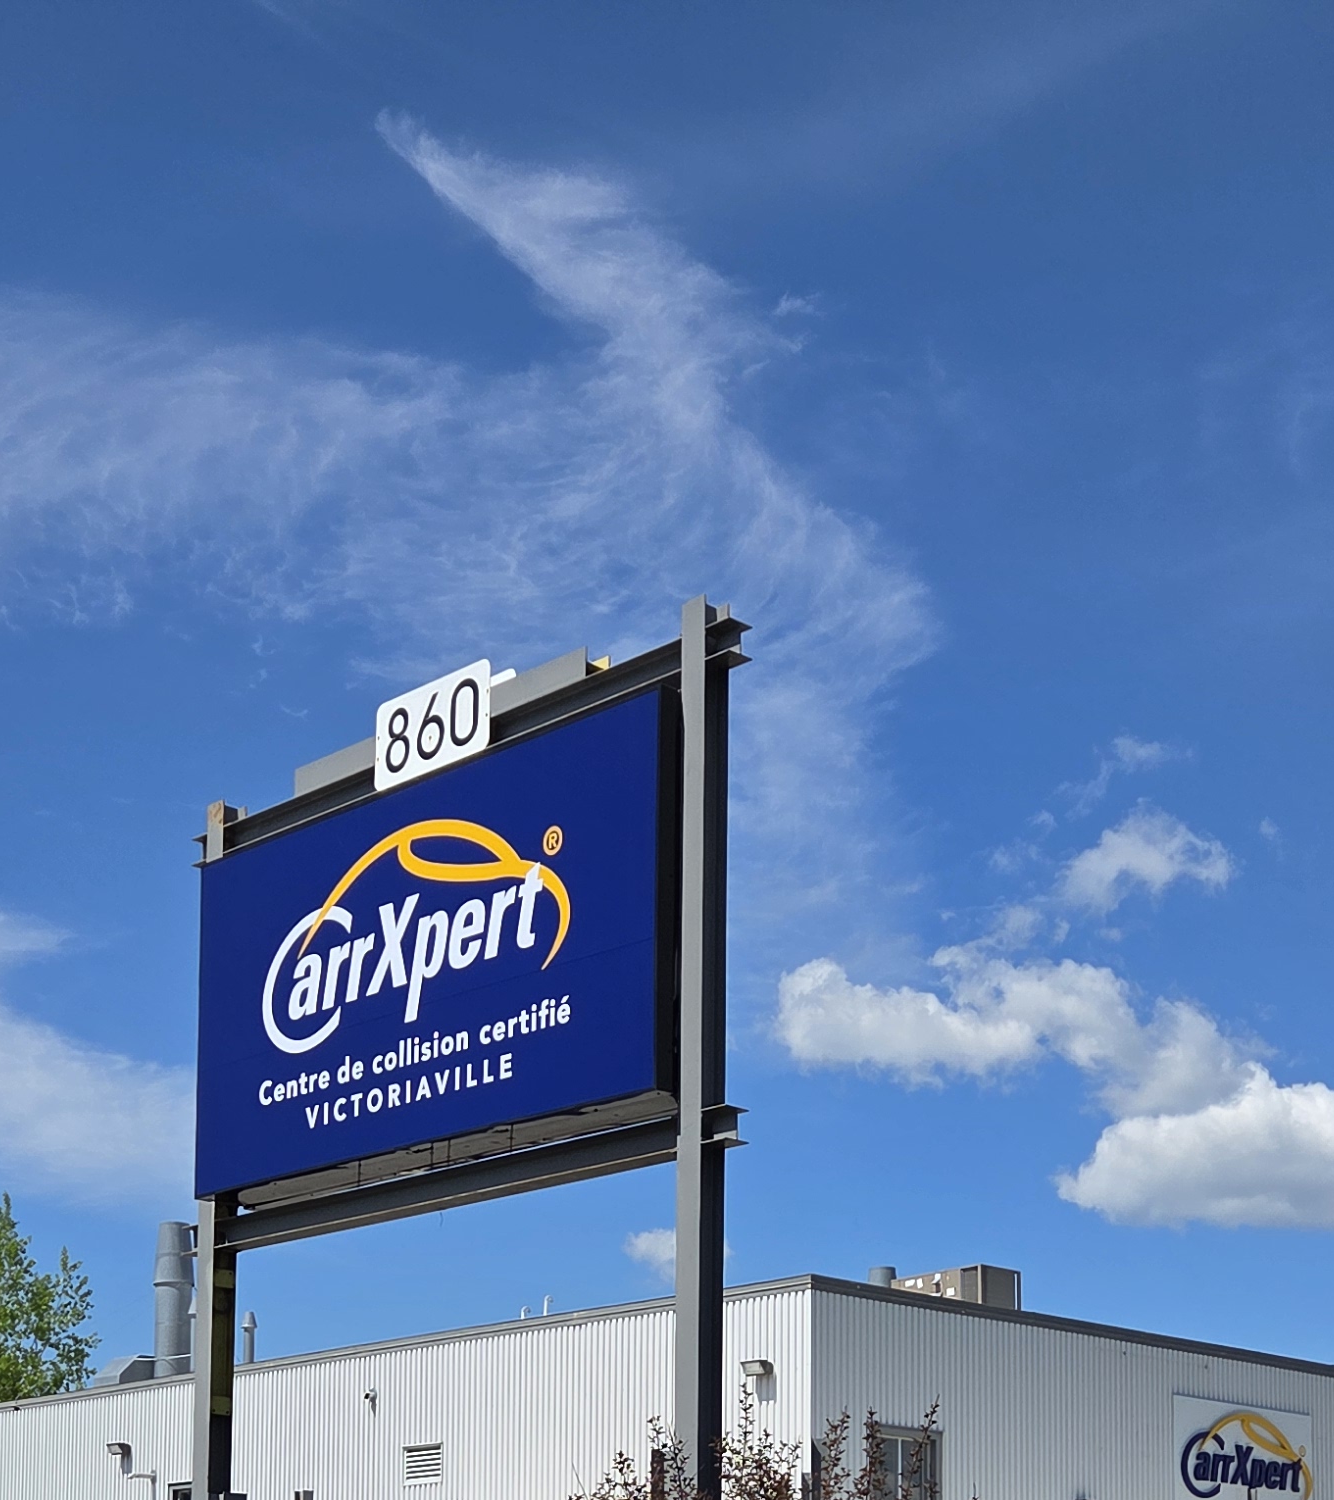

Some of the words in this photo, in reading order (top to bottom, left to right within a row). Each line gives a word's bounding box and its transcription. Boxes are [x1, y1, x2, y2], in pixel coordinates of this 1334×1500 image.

[385, 677, 480, 774] 860
[262, 862, 544, 1054] CarrXpert
[258, 1069, 331, 1106] Centre
[337, 1055, 364, 1085] de
[372, 1031, 469, 1075] collision
[479, 994, 571, 1045] certifié
[305, 1052, 514, 1130] VICTORIAVILLE
[1180, 1431, 1304, 1499] CarrXpert
